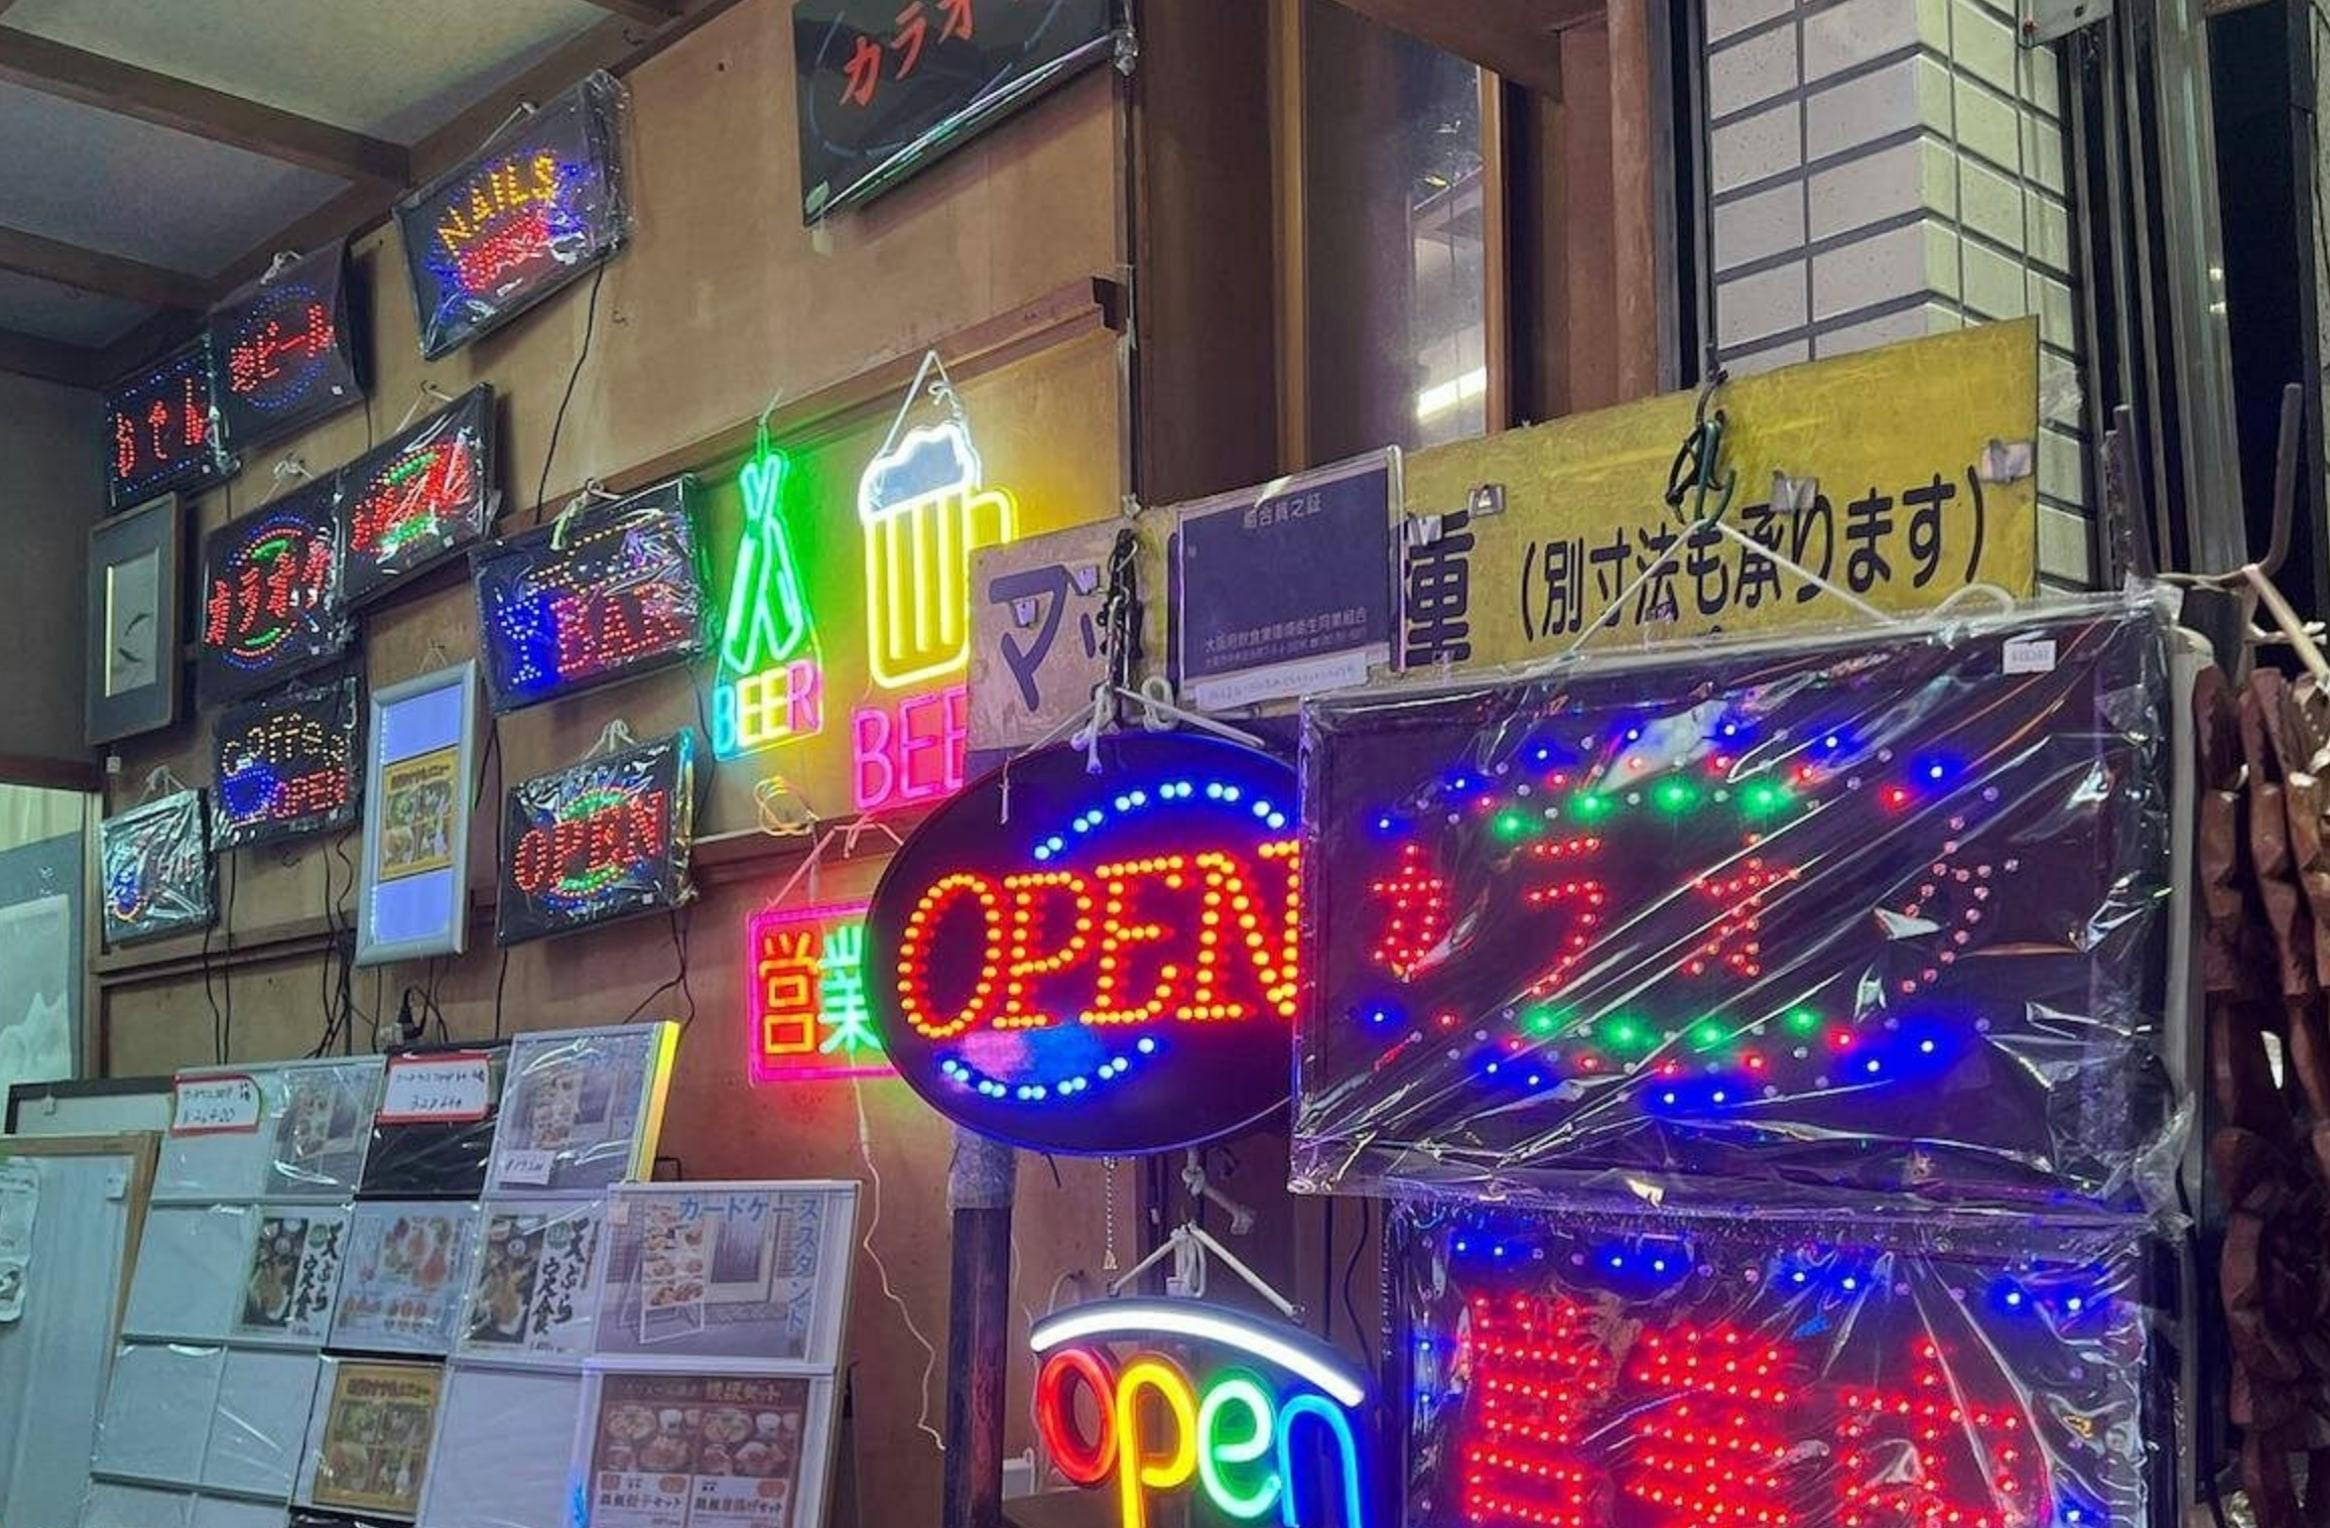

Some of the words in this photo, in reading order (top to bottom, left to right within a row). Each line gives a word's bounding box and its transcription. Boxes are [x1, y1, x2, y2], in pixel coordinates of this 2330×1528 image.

[437, 155, 556, 257] NAILS
[549, 578, 682, 678] BAR
[712, 660, 820, 754] BEER
[514, 789, 665, 891] OPEN
[897, 838, 1298, 1040] OPEN
[1036, 1348, 1363, 1527] open
